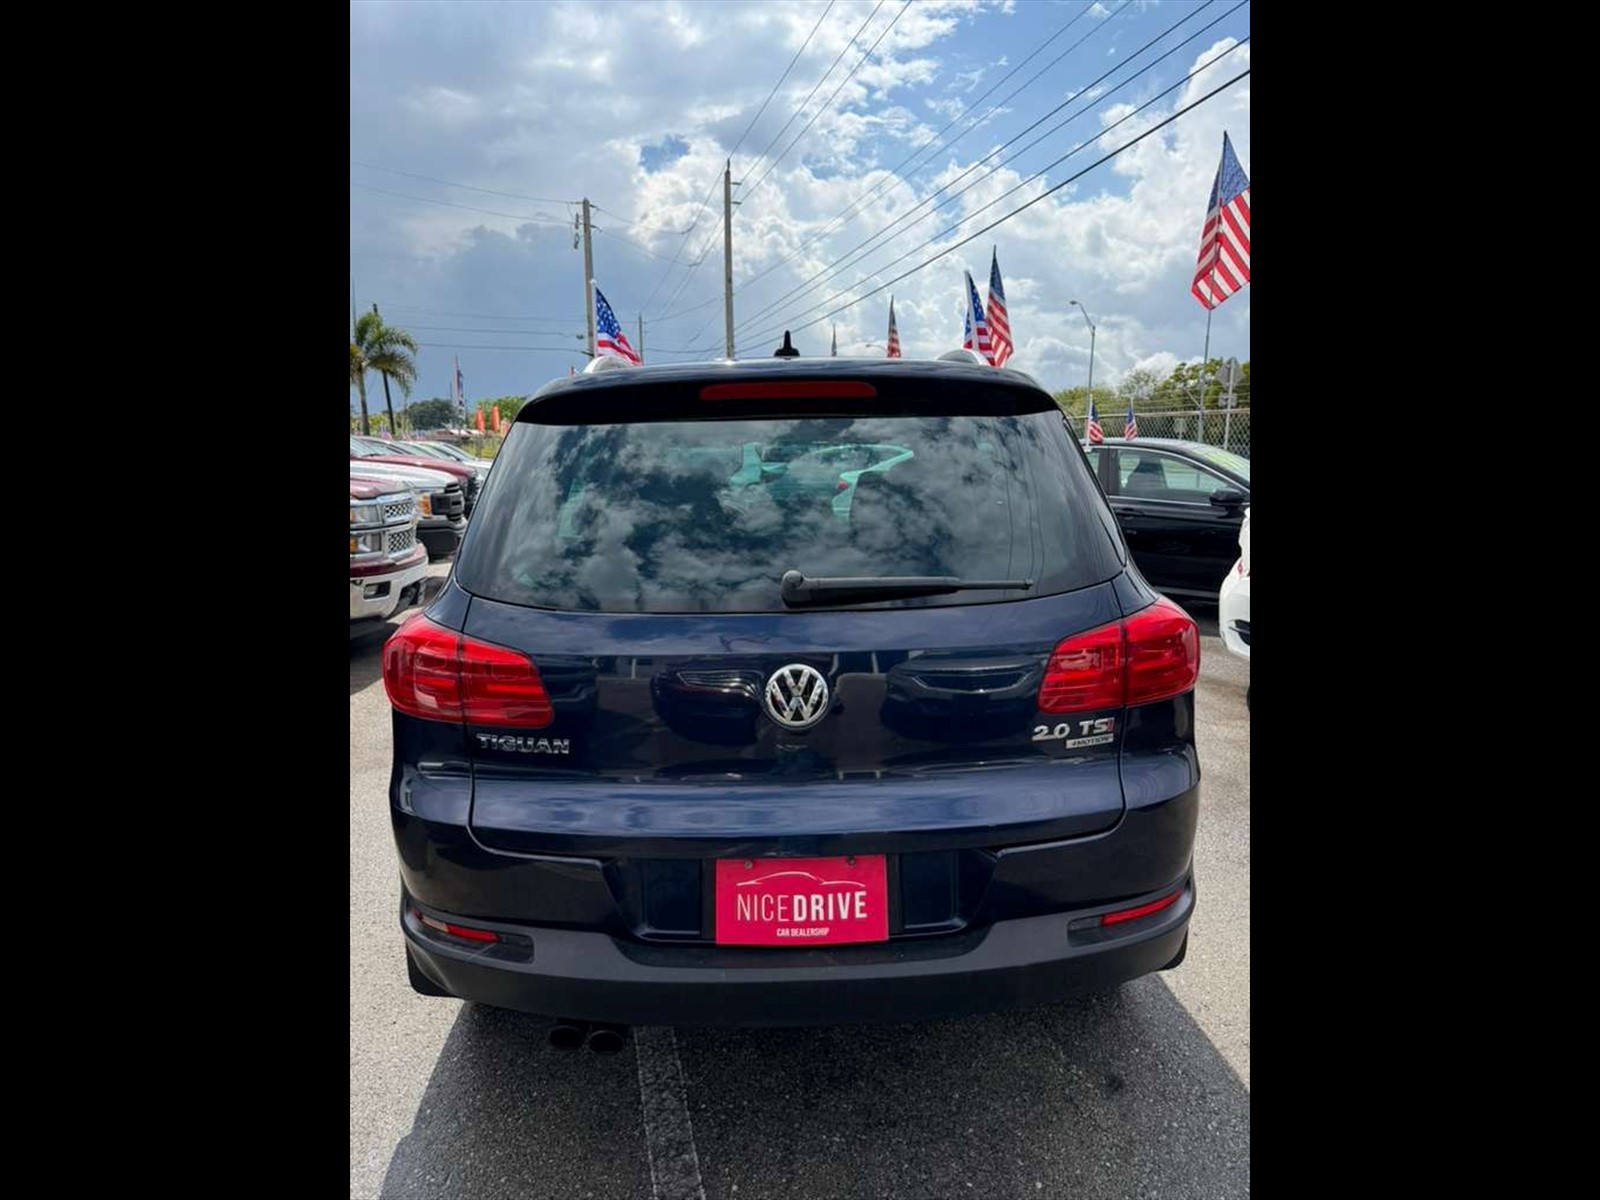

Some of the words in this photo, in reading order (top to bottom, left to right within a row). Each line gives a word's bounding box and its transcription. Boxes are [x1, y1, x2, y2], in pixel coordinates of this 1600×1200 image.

[767, 667, 827, 723] VW
[1032, 723, 1070, 741] 2.0
[476, 733, 570, 754] TIGUAN
[776, 927, 790, 937] CAR
[791, 927, 829, 937] DEALERSHIP
